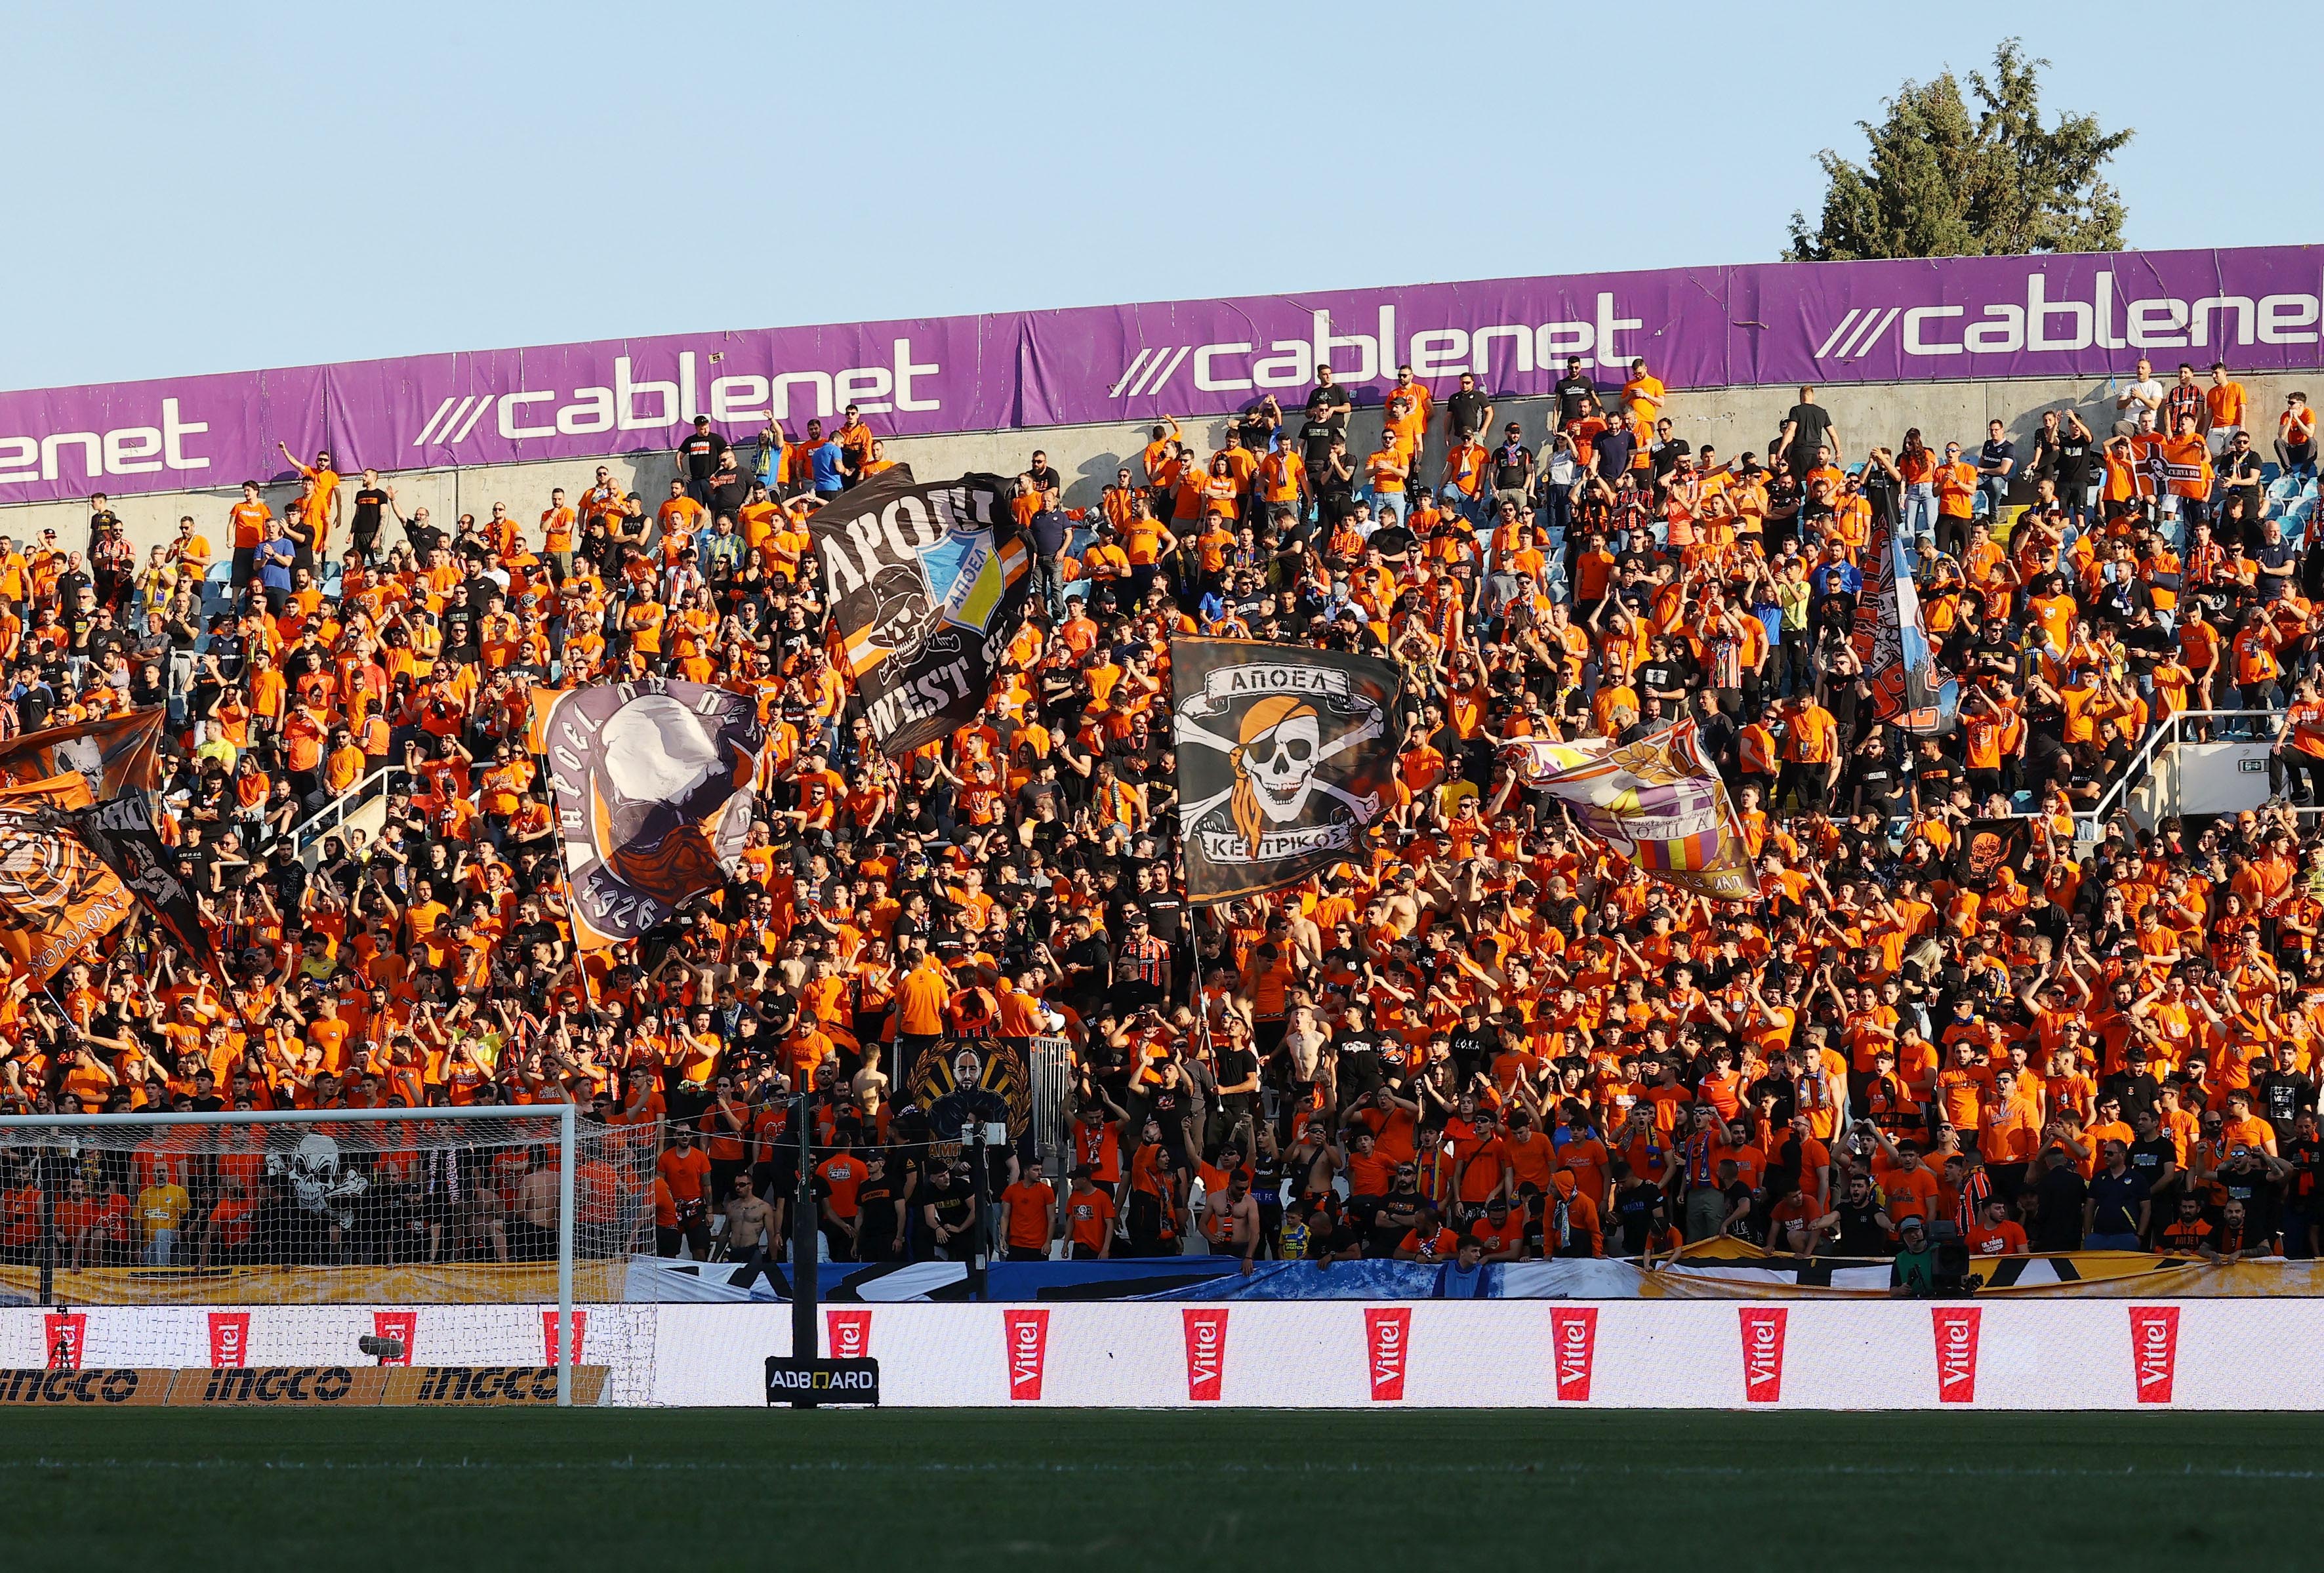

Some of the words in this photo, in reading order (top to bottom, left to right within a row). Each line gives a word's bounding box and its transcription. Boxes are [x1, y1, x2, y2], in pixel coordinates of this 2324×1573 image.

[1193, 292, 1643, 392] cablenet
[1903, 271, 2324, 355] cablene
[498, 338, 941, 441] cablenet
[950, 548, 987, 610] ΑΠΟΕΛ
[866, 657, 971, 741] WEST
[1231, 669, 1326, 692] ΑΠΟΕΛ
[582, 875, 657, 931] 1926
[1982, 1238, 2003, 1248] ULTRAS
[218, 1323, 240, 1368] ittel
[838, 1321, 860, 1358] ttel
[1013, 1320, 1038, 1386] Vittel
[1193, 1320, 1217, 1386] Vittel
[1376, 1320, 1400, 1386] Vittel
[1561, 1319, 1586, 1386] Vittel
[1750, 1320, 1775, 1387] Vittel
[1944, 1319, 1969, 1387] Vittel
[2142, 1319, 2167, 1387] Vittel
